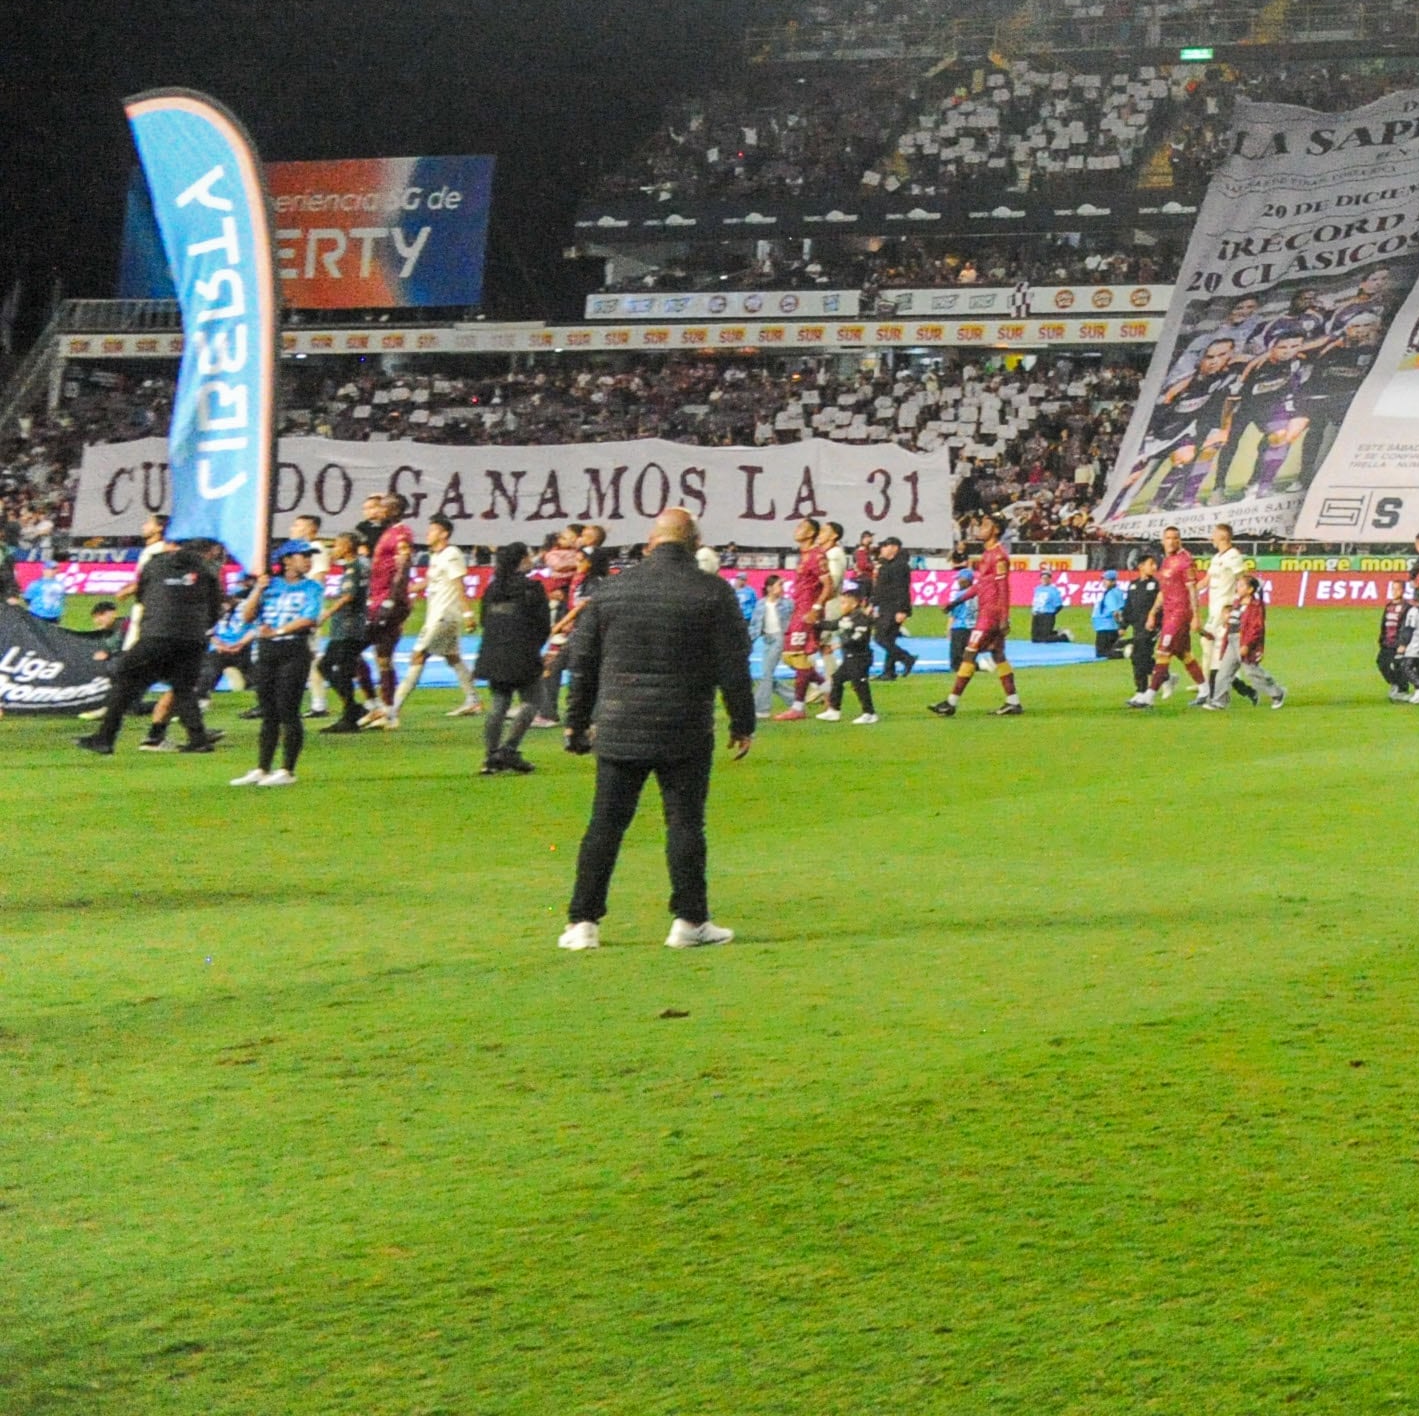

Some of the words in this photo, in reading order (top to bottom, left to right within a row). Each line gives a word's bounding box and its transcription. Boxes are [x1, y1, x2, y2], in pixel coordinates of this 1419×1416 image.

[427, 186, 463, 210] de
[1261, 203, 1288, 219] 20
[1294, 200, 1329, 217] DE
[1185, 270, 1223, 294] 20
[1079, 325, 1106, 339] SUR
[1120, 324, 1147, 338] SUR
[104, 460, 353, 516] CUDO
[389, 461, 708, 522] GANAMOS
[736, 464, 828, 521] LA
[863, 468, 925, 523] 31
[1372, 496, 1404, 529] S
[1280, 557, 1350, 572] monge
[1316, 580, 1387, 600] ESTA
[0, 646, 65, 682] Liga
